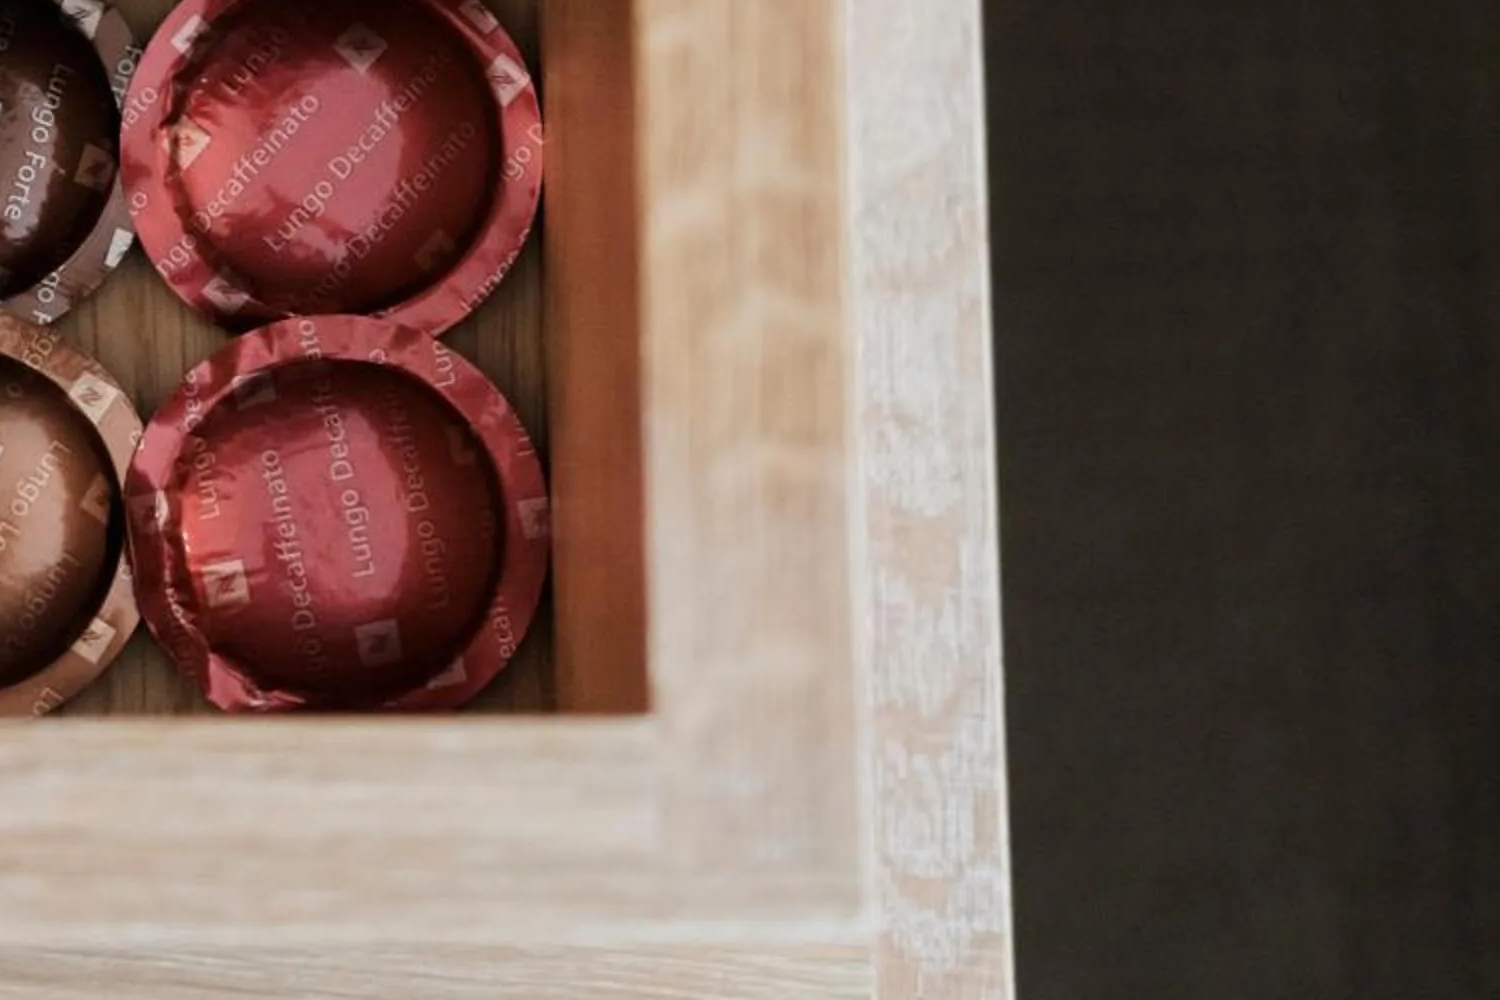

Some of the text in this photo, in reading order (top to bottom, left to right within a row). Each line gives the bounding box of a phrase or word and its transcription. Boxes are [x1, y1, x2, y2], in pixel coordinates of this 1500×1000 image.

[2, 63, 75, 220] Lungo Forte
[264, 47, 454, 251] Lungo Decaffeinato
[347, 120, 476, 260] Decaffeinato
[10, 440, 72, 517] Lungo
[193, 437, 231, 520] Lungo
[340, 488, 377, 578] Lungo
[417, 519, 449, 610] Lungo
